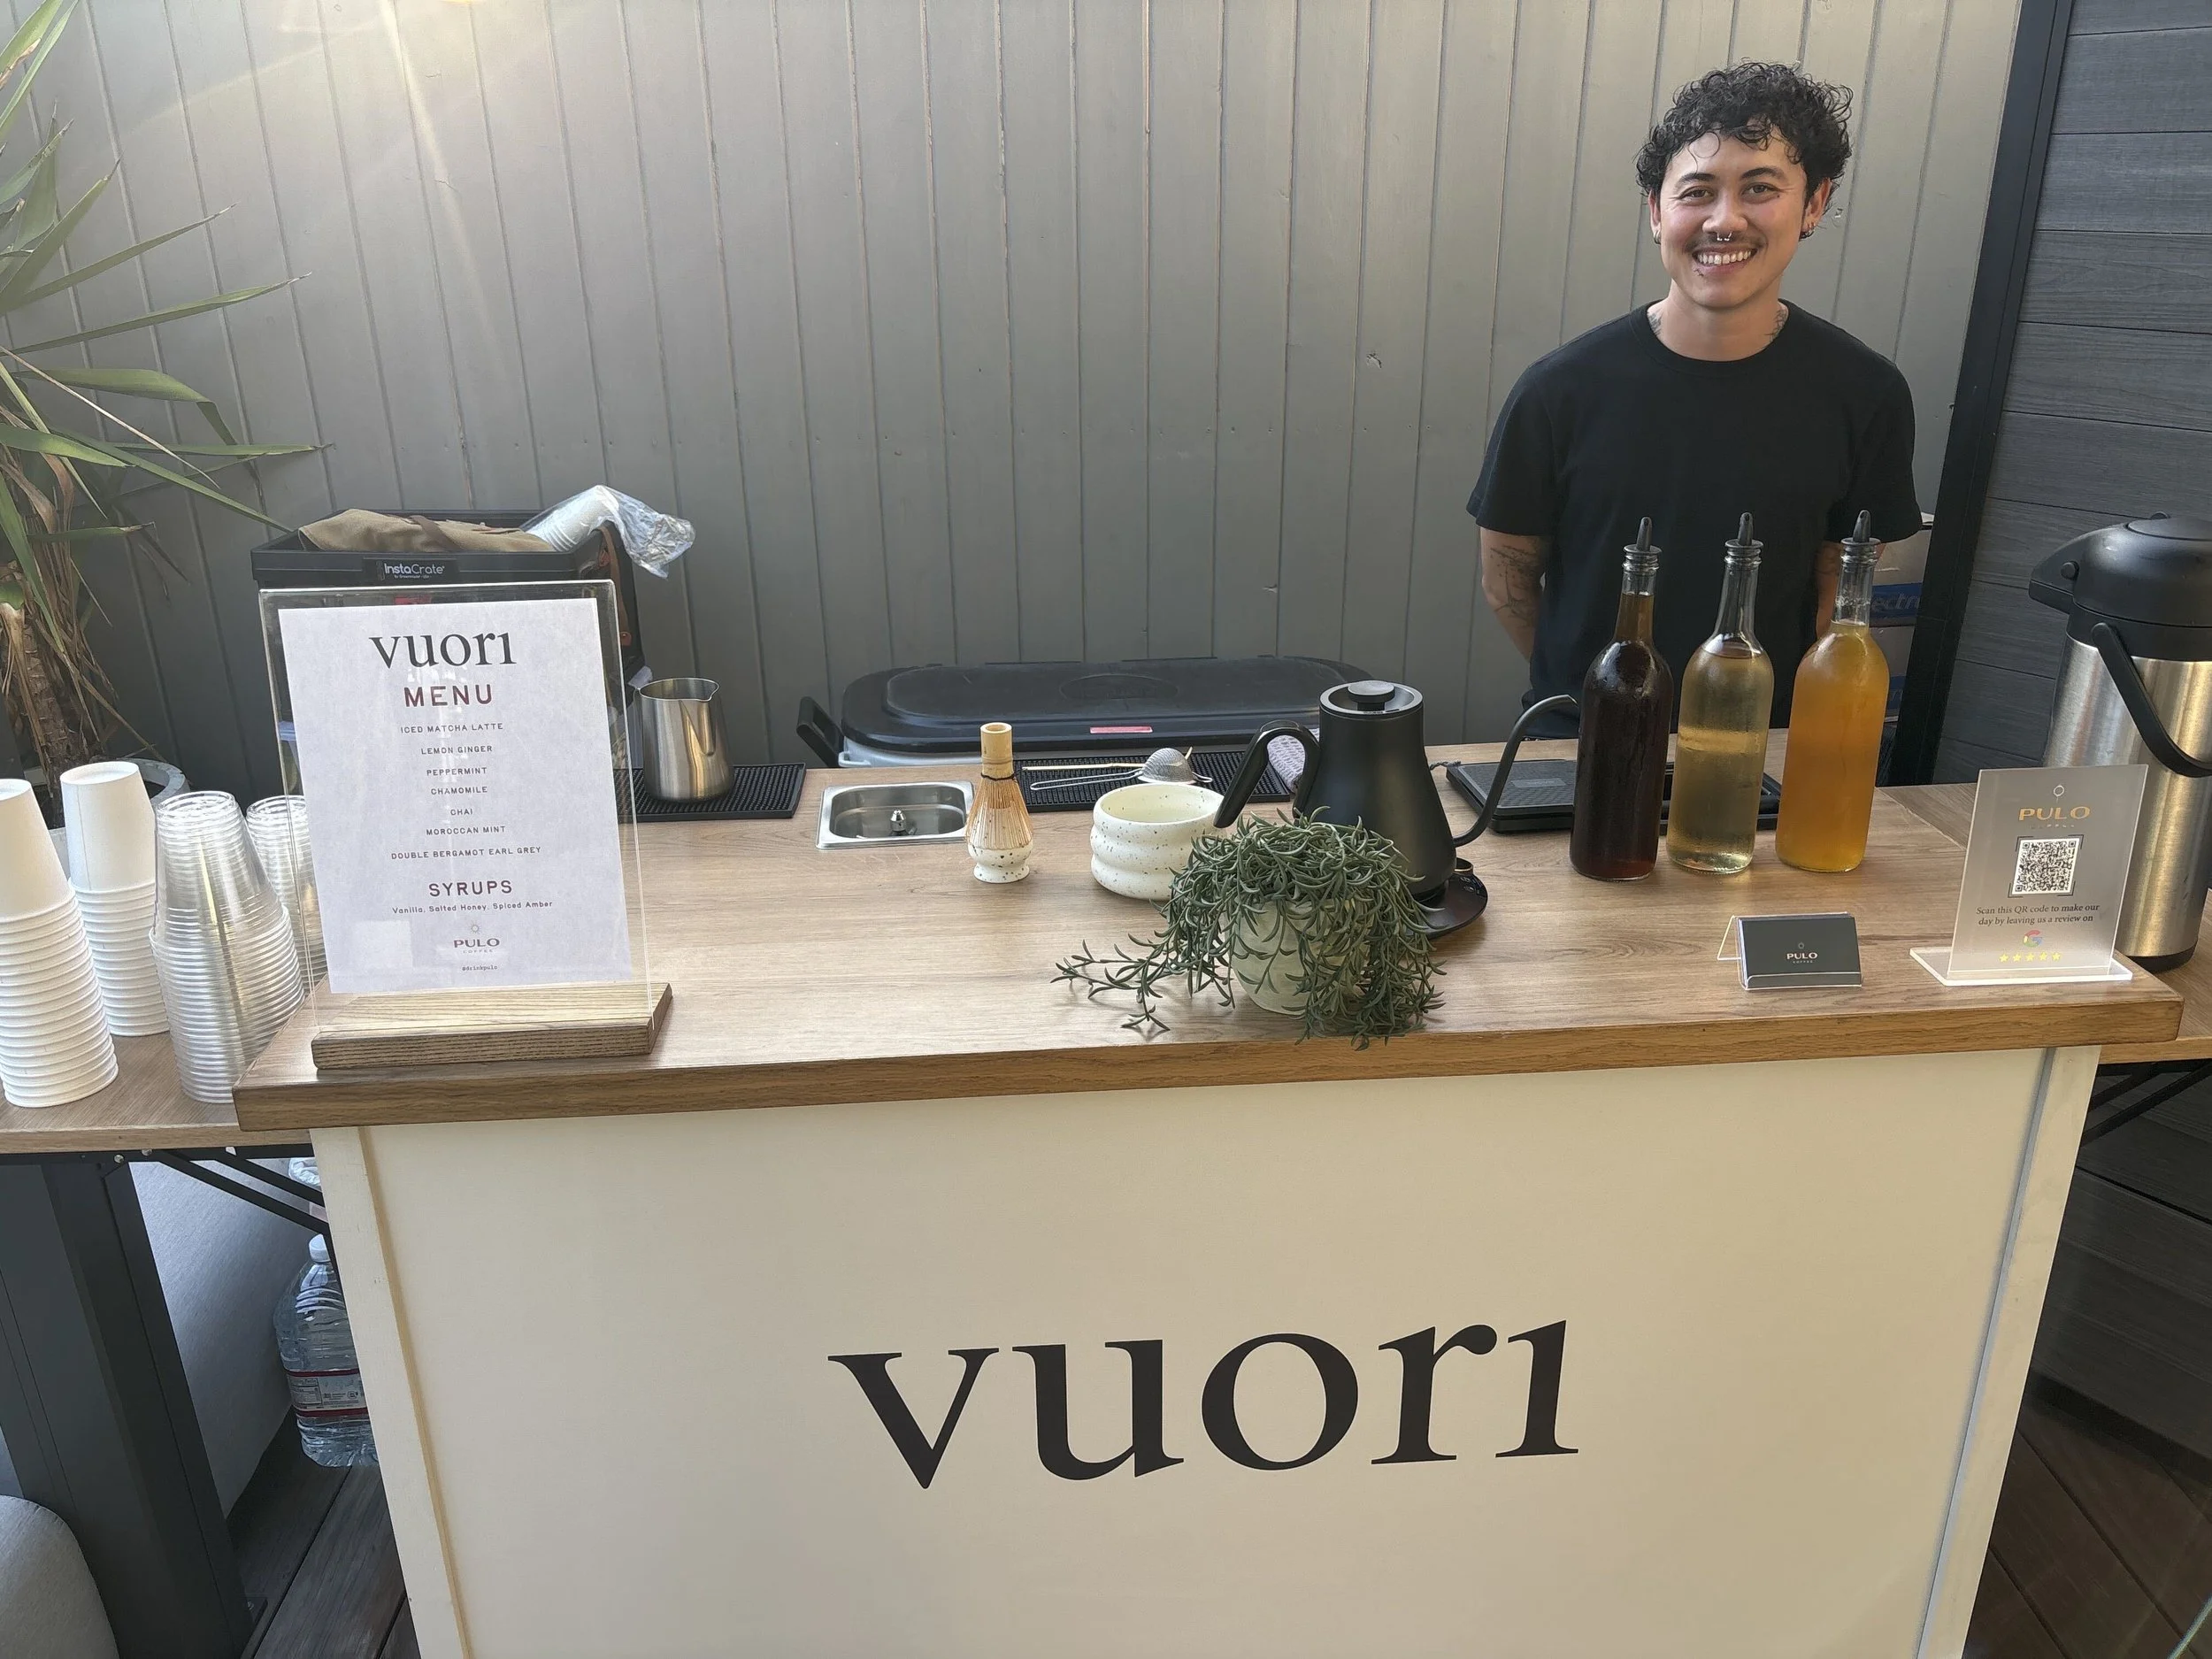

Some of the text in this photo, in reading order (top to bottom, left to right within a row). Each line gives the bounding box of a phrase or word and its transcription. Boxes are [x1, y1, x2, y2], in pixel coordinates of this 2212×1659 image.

[403, 684, 492, 707] MENU
[427, 724, 467, 733] MATCHA
[426, 767, 488, 776] PEPPERMINT
[430, 786, 488, 795] CHAMOMILE
[2018, 806, 2091, 821] PULO
[426, 826, 479, 835] MOROCCAN
[391, 851, 429, 860] DOUBLE
[433, 849, 484, 858] BERGAMOT
[428, 879, 512, 897] SYRUPS
[493, 902, 522, 910] Spiced
[1976, 906, 1995, 915] Scan
[1997, 905, 2013, 914] this
[2014, 905, 2028, 914] QR
[2030, 904, 2049, 913] code
[2061, 903, 2083, 912] make
[1978, 917, 1993, 926] day
[1994, 917, 2005, 926] by
[2007, 916, 2035, 926] leaving
[453, 938, 501, 949] PULO
